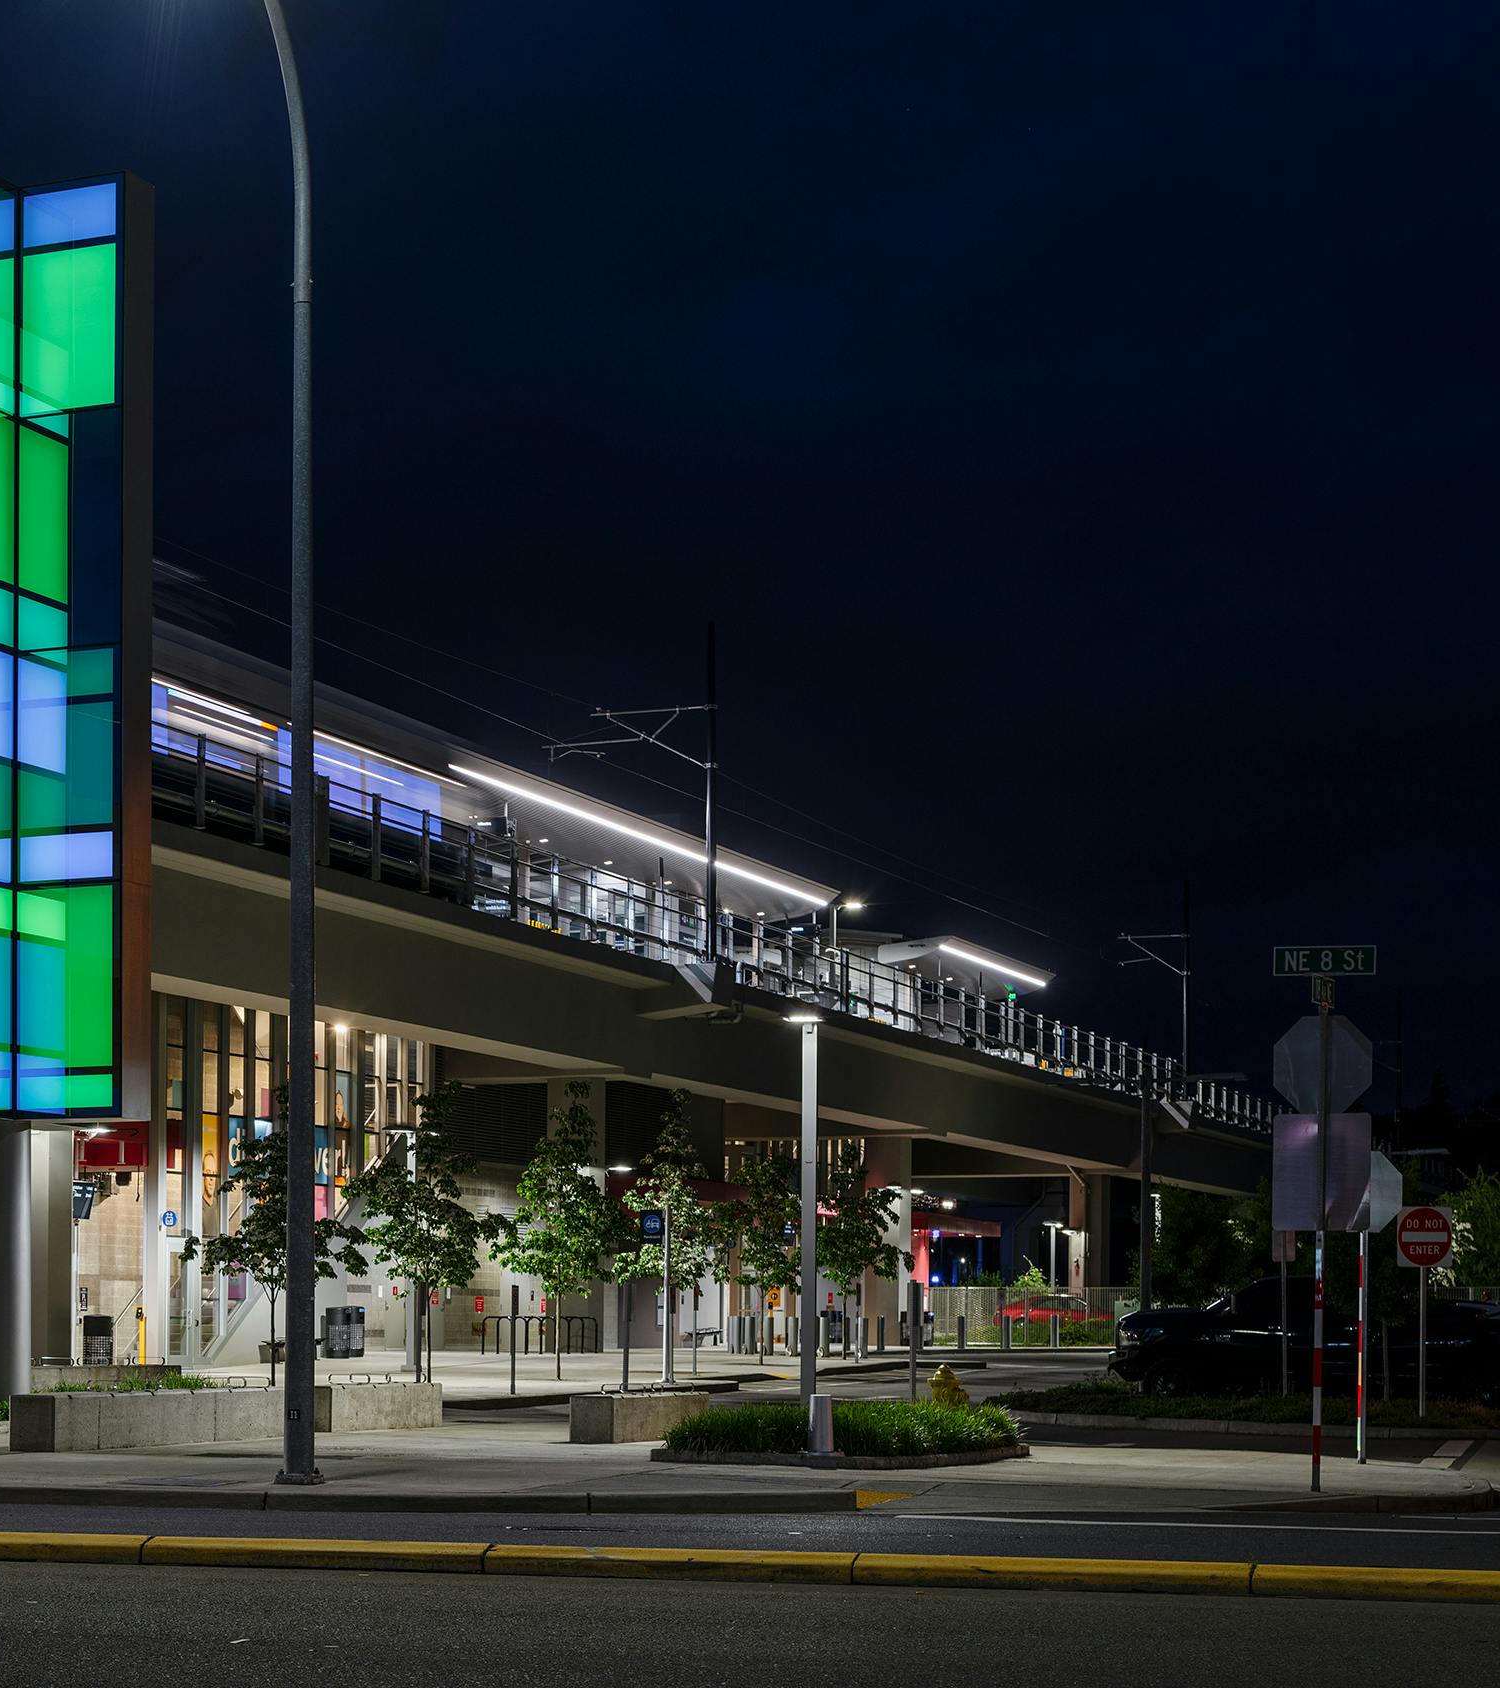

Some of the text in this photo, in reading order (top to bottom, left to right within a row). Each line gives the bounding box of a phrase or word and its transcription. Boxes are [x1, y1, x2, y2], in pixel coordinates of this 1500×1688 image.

[1284, 950, 1365, 971] NE 8 St
[1406, 1219, 1444, 1229] DO NOT
[1409, 1245, 1440, 1255] ENTER
